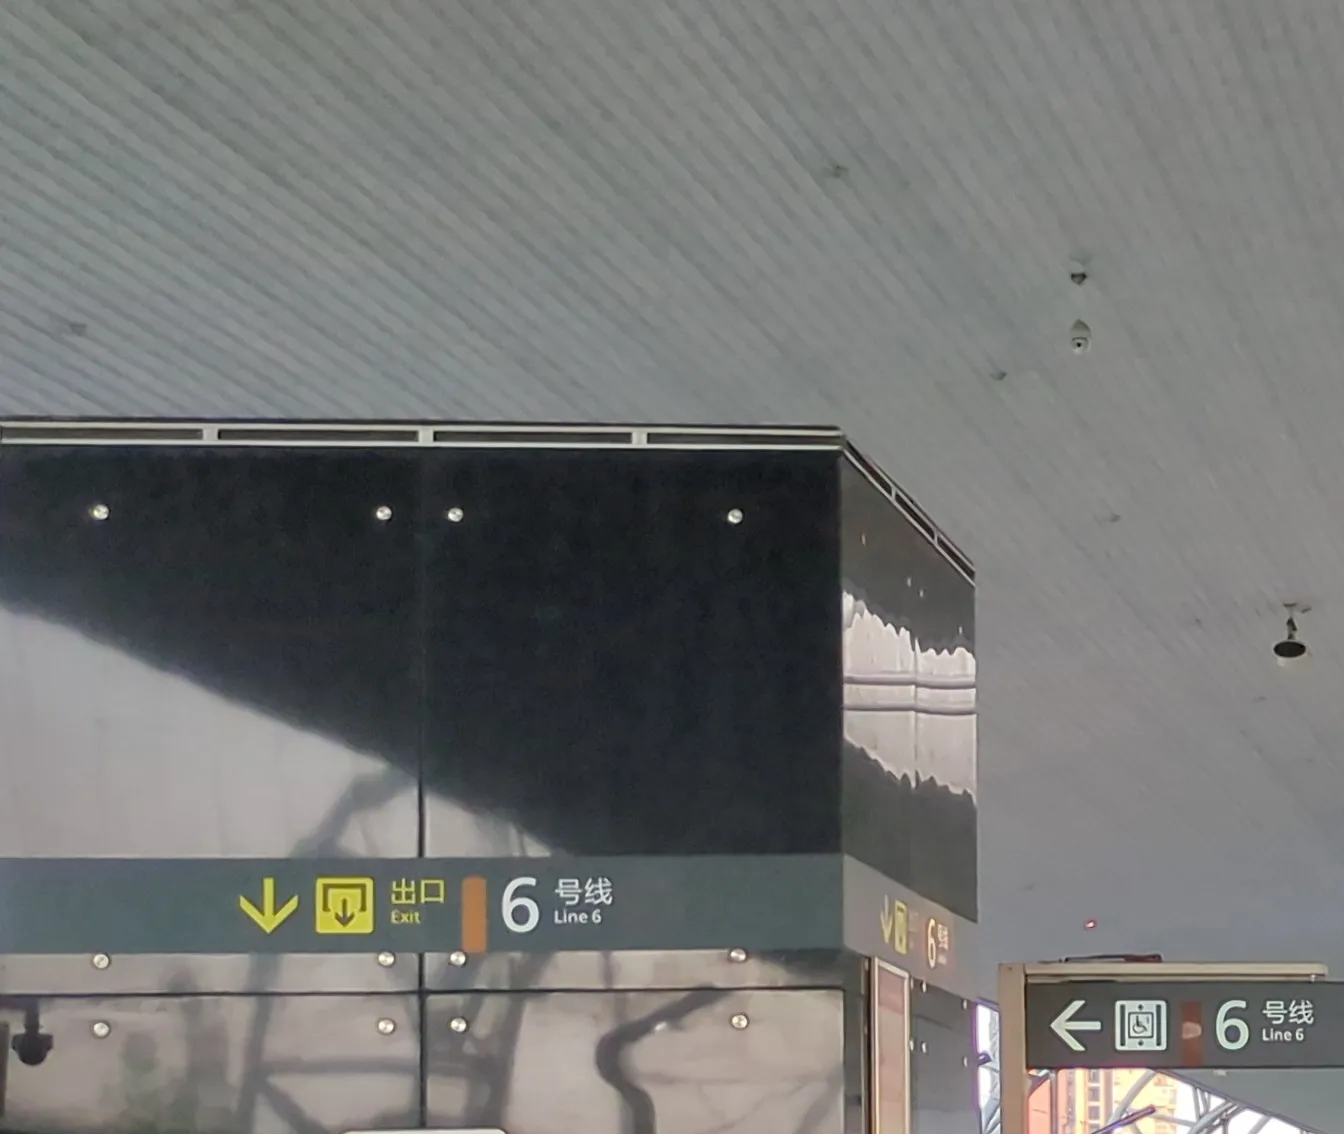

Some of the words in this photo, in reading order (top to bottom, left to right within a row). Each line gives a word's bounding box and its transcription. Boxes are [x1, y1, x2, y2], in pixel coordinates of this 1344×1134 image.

[390, 877, 445, 904] 出口
[501, 876, 540, 933] 6
[554, 877, 613, 905] 号线
[390, 910, 421, 924] Exit
[554, 910, 588, 924] Line
[591, 910, 602, 924] 6
[1215, 999, 1250, 1050] 6
[1262, 999, 1314, 1025] 号线
[1261, 1028, 1293, 1041] Line
[1295, 1028, 1305, 1041] 6
